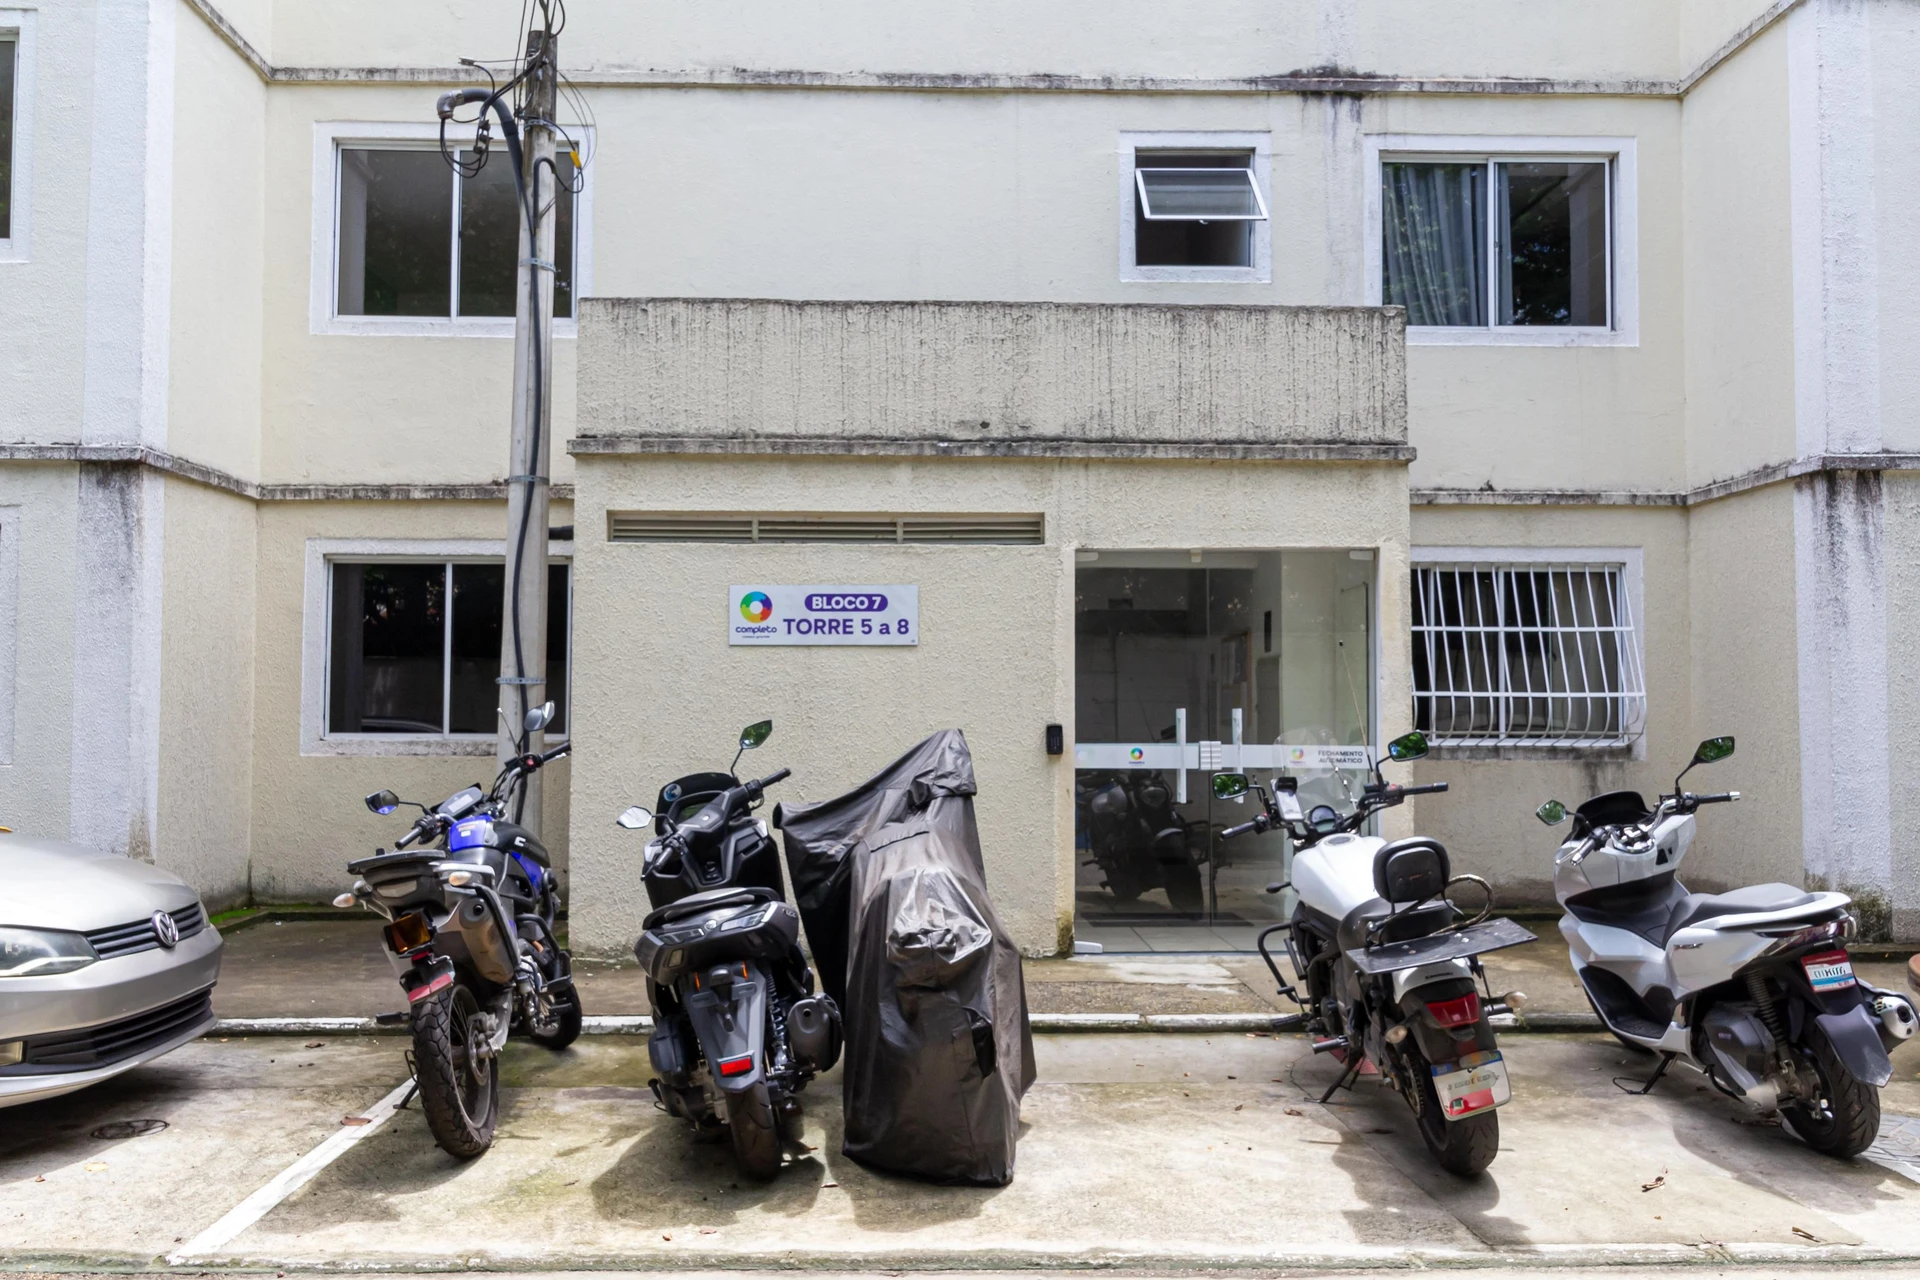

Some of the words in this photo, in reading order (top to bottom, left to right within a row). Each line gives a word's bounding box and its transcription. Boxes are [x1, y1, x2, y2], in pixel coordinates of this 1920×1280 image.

[812, 596, 869, 609] BLOCO
[872, 597, 881, 609] 7
[735, 625, 777, 634] completo
[783, 619, 854, 635] TORRE
[861, 619, 872, 635] 5
[879, 623, 890, 635] a
[897, 619, 909, 635] 8
